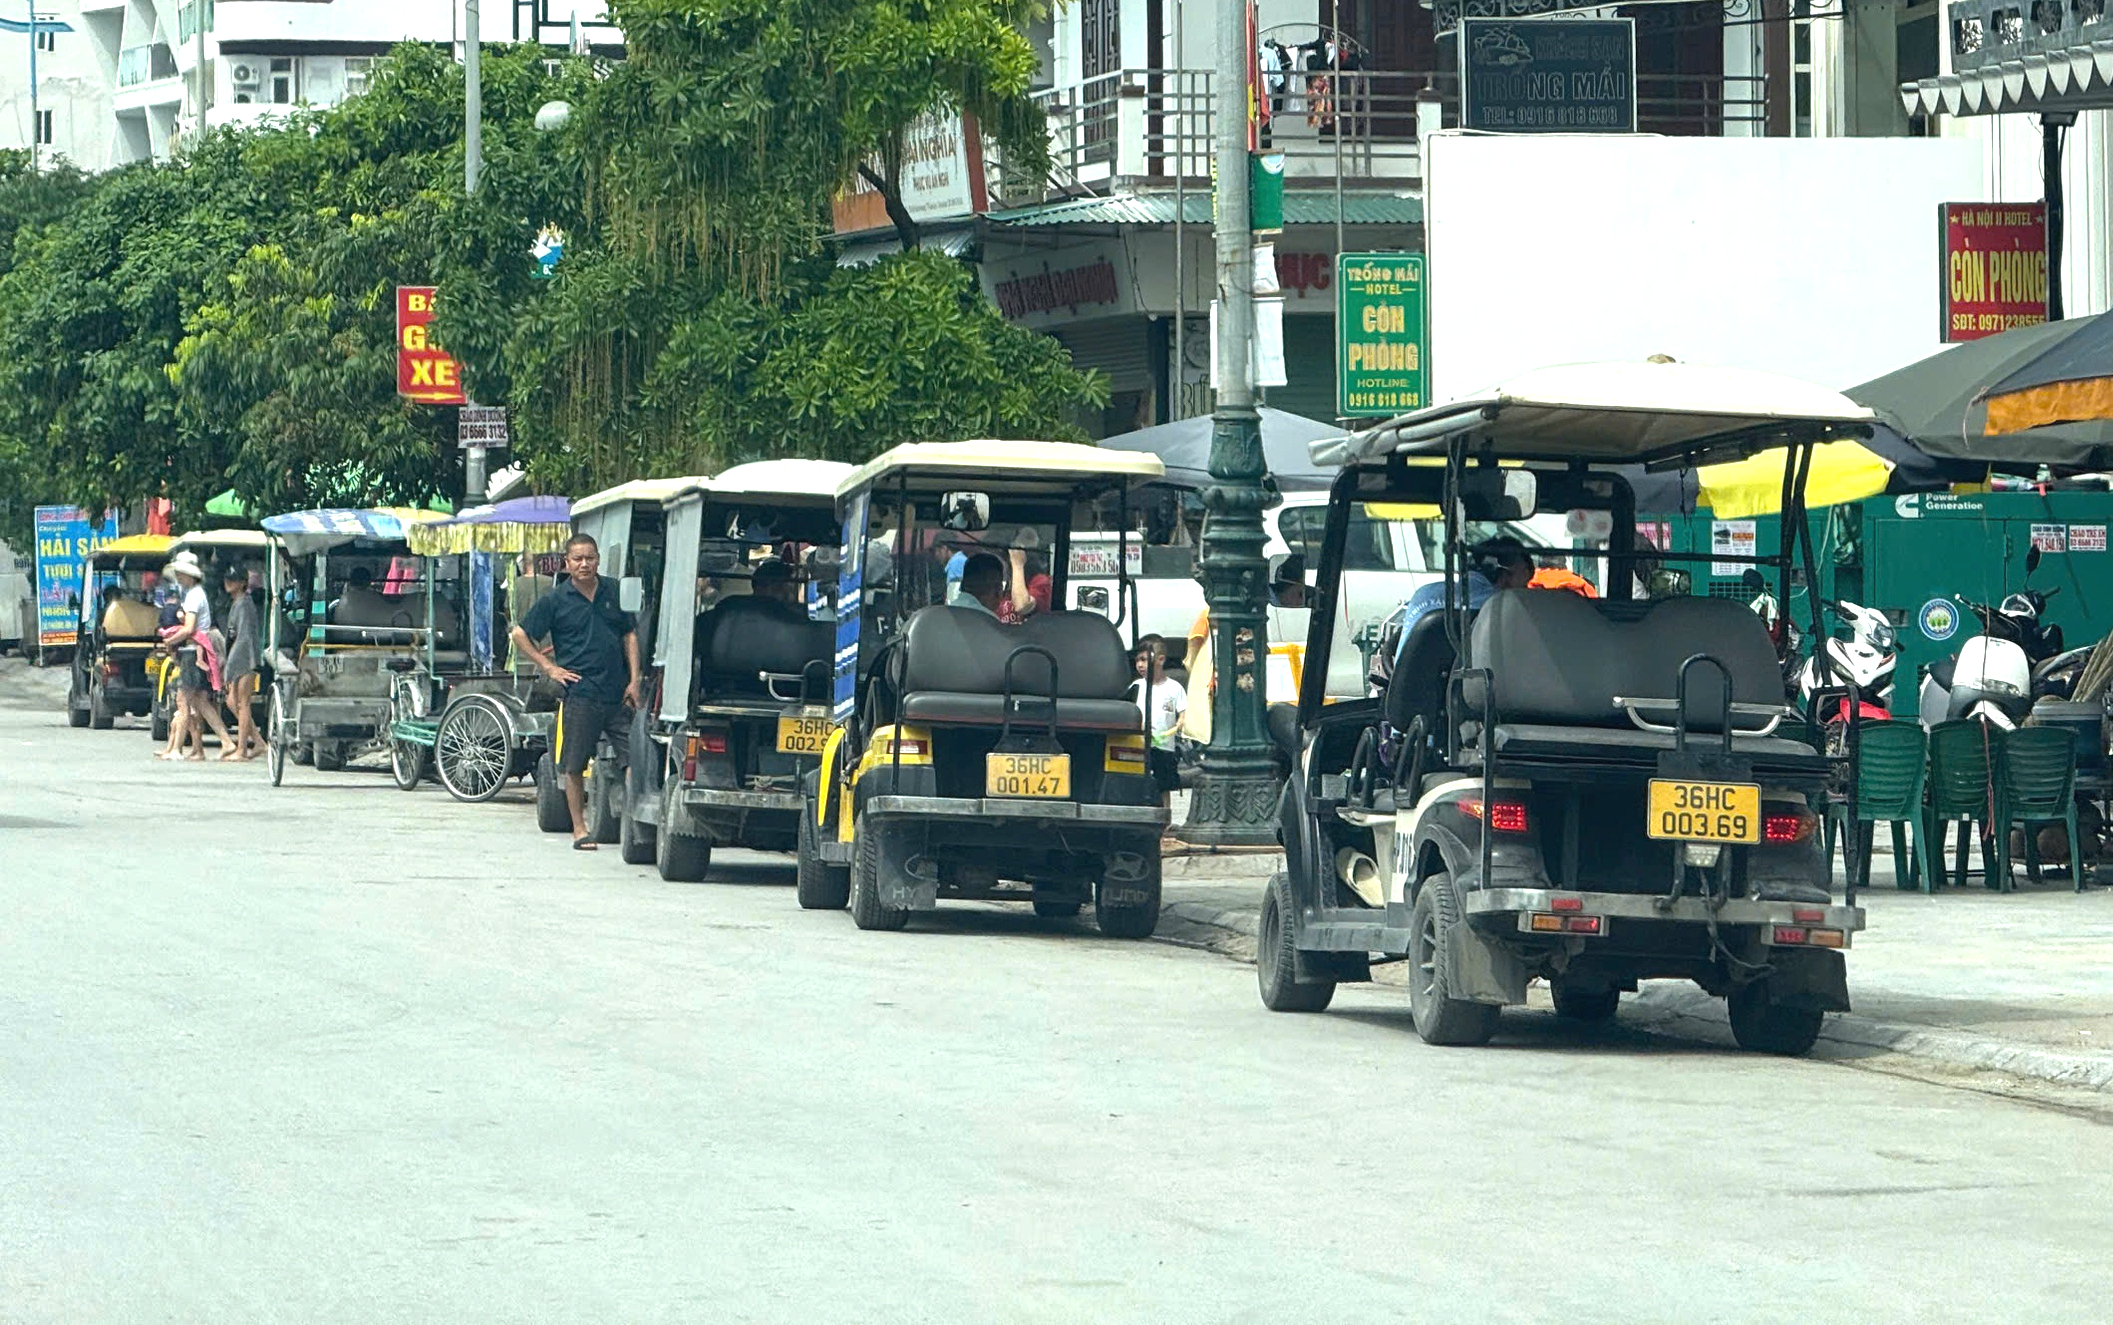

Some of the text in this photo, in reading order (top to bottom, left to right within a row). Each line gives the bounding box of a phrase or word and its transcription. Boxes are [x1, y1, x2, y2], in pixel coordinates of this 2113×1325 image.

[1517, 106, 1555, 124] 0916
[2005, 211, 2033, 226] HOTEL
[1951, 237, 2046, 303] CÒN PHÒNG
[1366, 283, 1402, 295] HOTEL
[1362, 300, 1405, 333] CÒN
[1348, 337, 1419, 371] PHÒNG
[410, 359, 456, 386] XE
[1350, 392, 1375, 407] 0916
[1925, 501, 1984, 510] Generation
[1926, 493, 1958, 501] Power
[794, 719, 835, 736] 36HC
[785, 736, 828, 751] 002.9
[1005, 757, 1052, 775] 36HC
[996, 776, 1061, 795] 001.47
[1674, 785, 1736, 811] 36HC
[1662, 811, 1747, 839] 003.69
